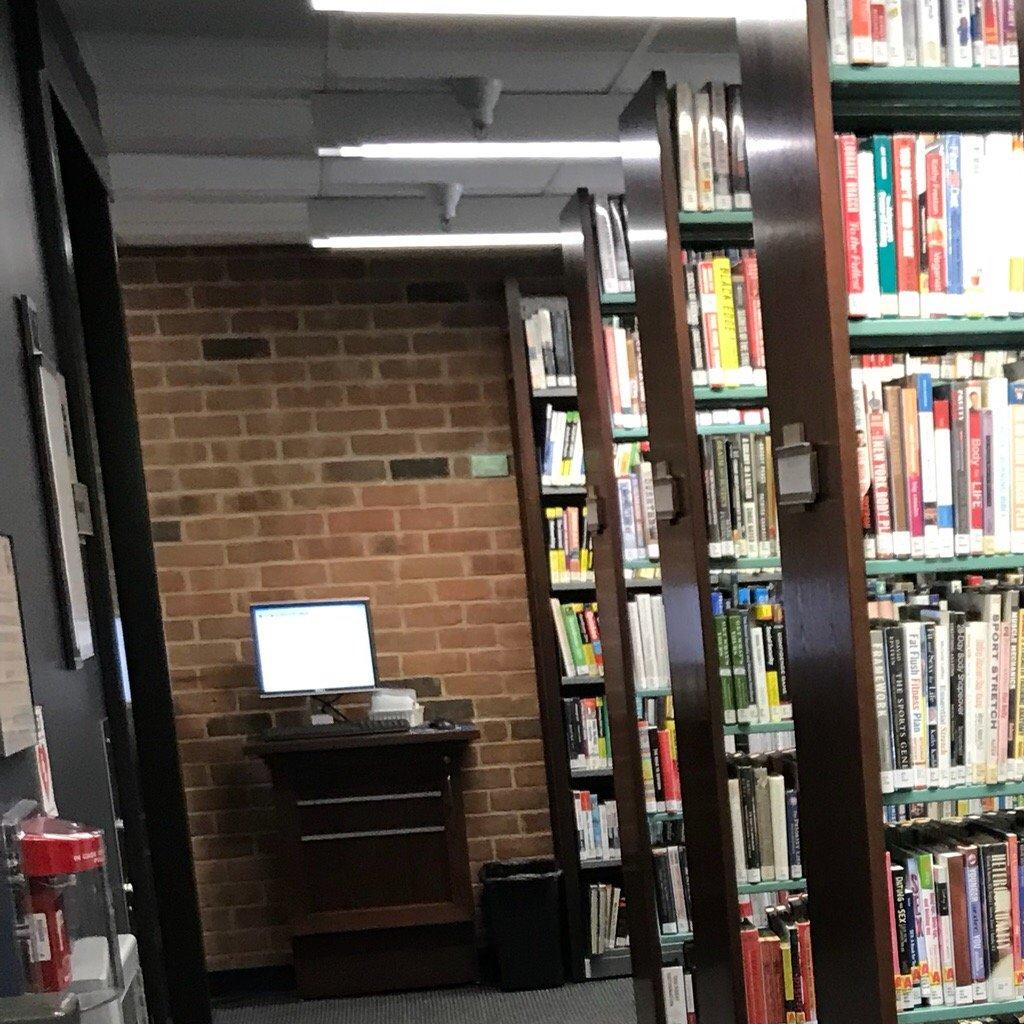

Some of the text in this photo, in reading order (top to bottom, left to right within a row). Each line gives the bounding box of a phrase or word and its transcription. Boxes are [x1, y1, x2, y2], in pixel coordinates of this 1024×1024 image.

[909, 634, 918, 648] Fat
[911, 652, 920, 675] Flush
[872, 643, 887, 717] FRAMEWORK
[898, 698, 906, 737] SPORTS
[913, 713, 922, 732] Plan
